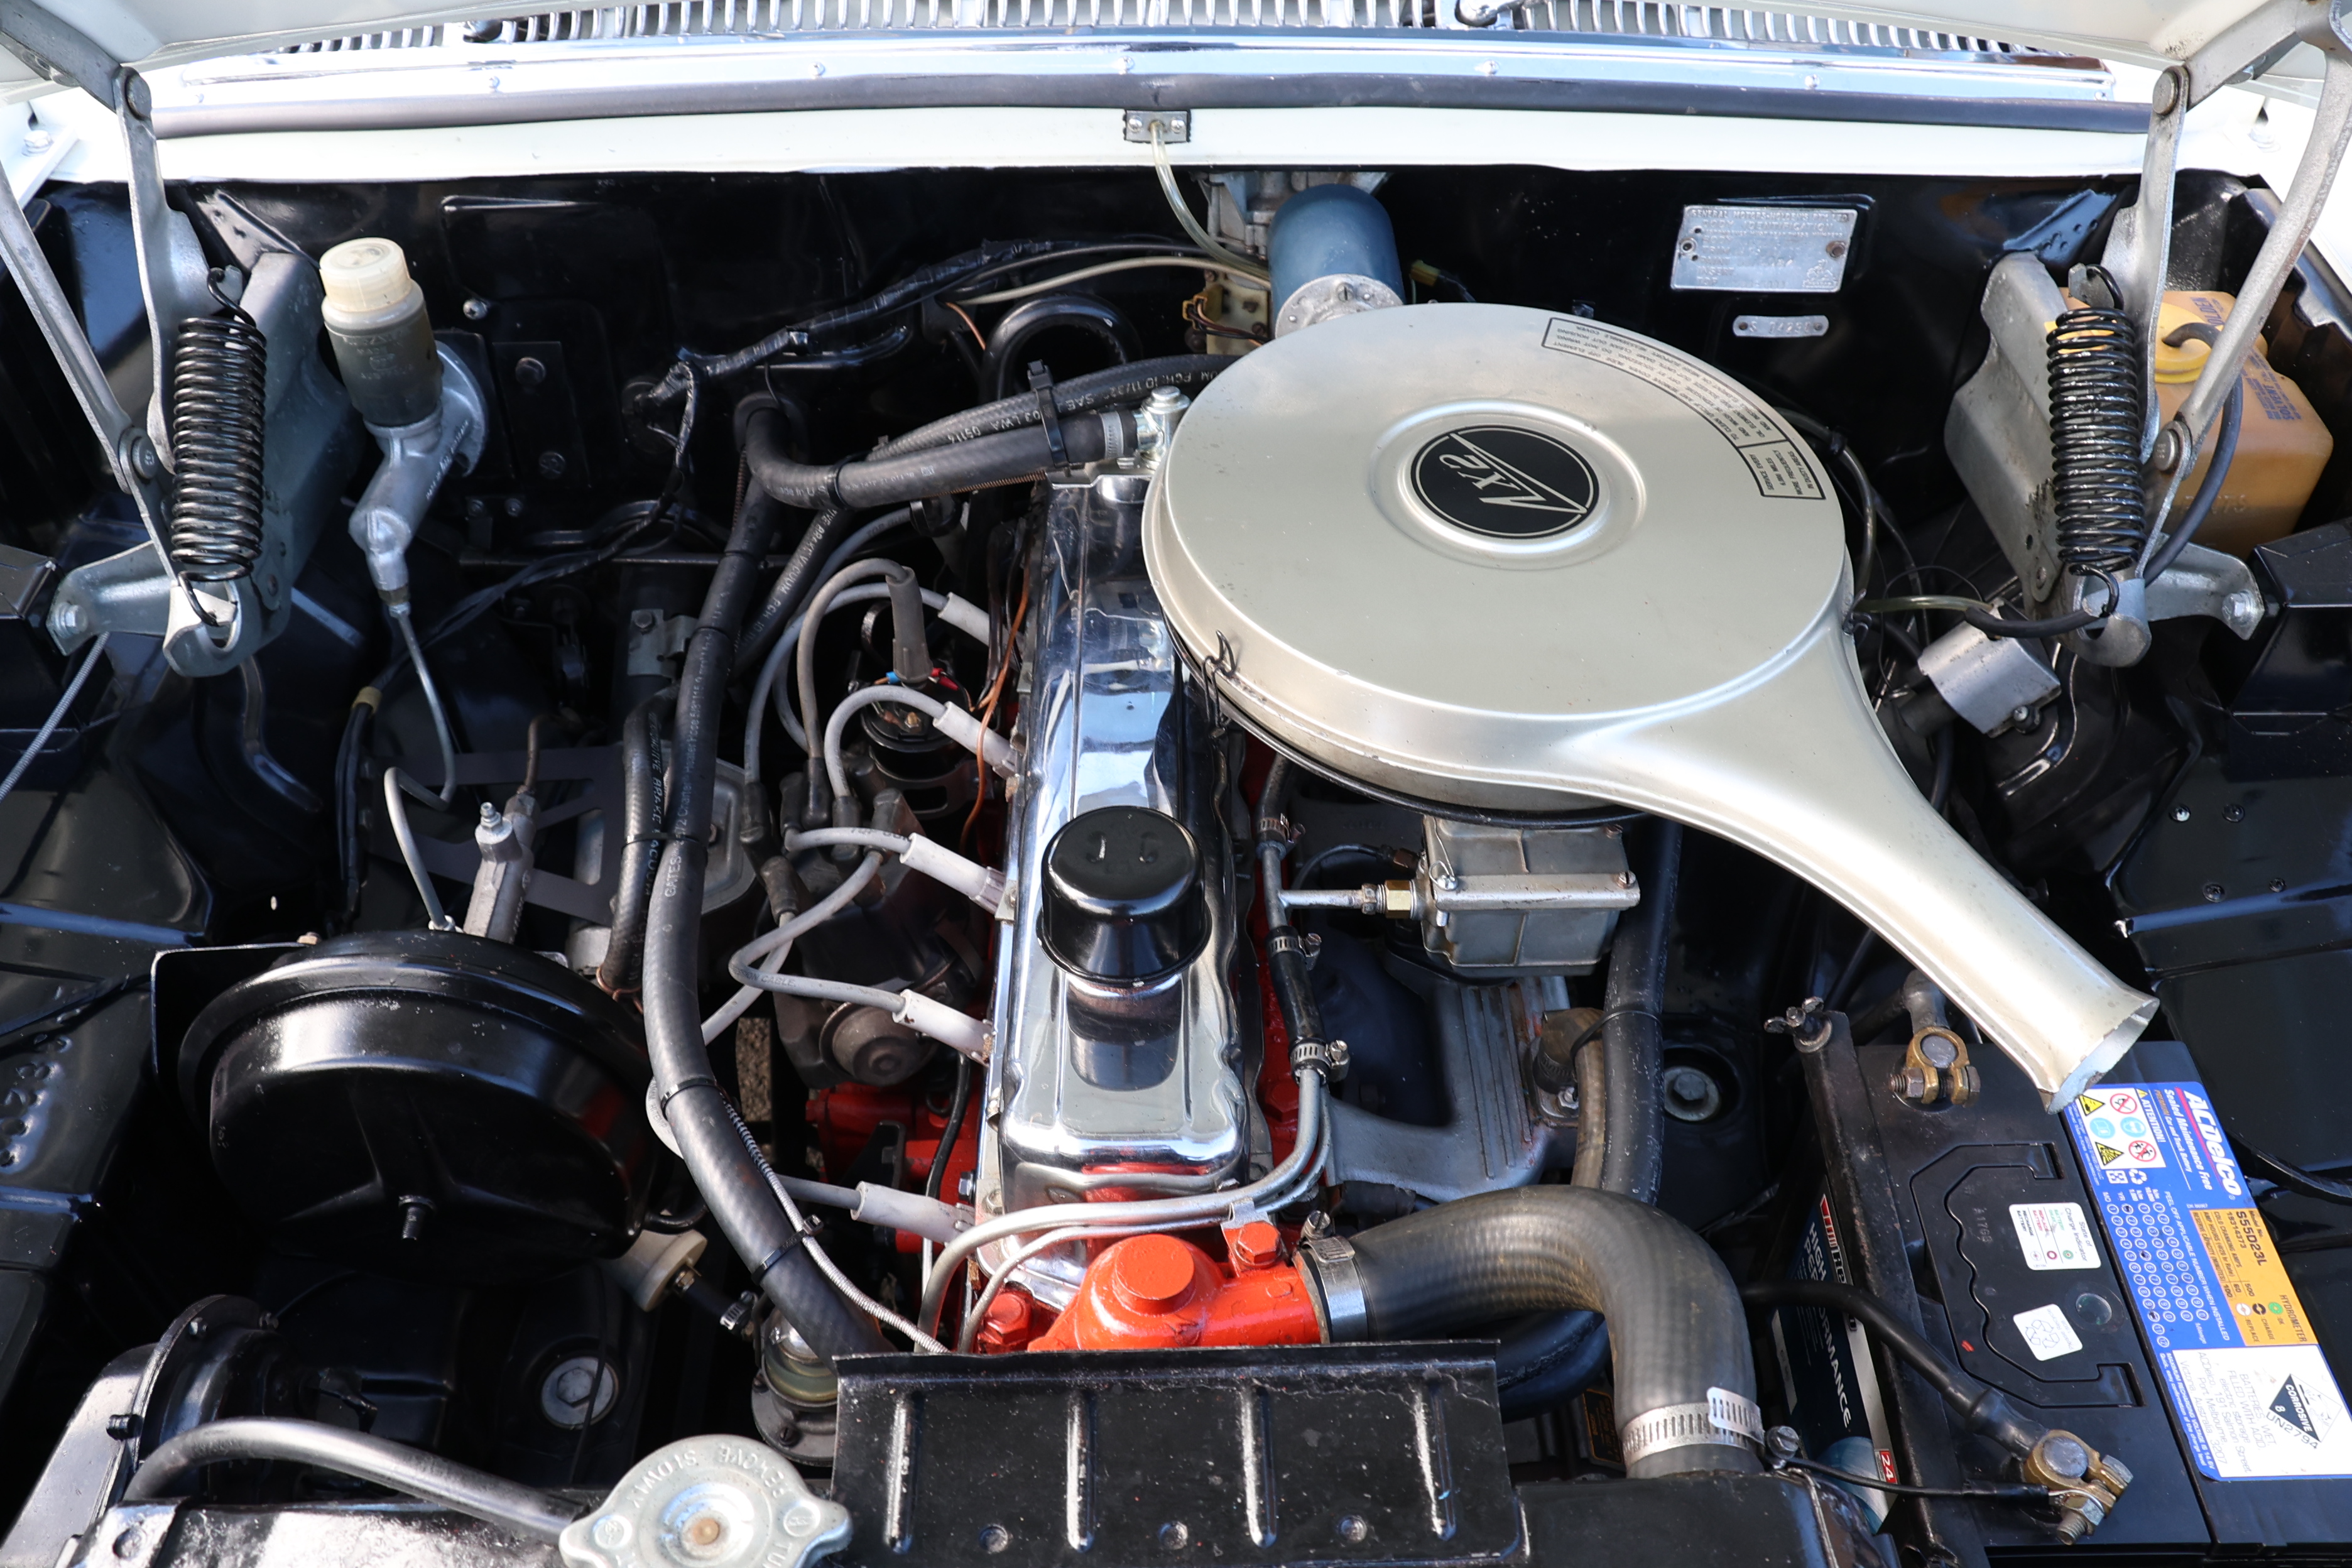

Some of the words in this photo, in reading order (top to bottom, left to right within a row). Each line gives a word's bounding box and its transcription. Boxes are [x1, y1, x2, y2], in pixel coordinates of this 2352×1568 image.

[1690, 207, 1729, 219] GENERAL
[1743, 218, 1834, 233] IDENTIFICATION
[1759, 470, 1775, 490] SERVICE
[663, 854, 682, 898] GATES
[2139, 1097, 2167, 1143] ATTENTION!
[2164, 1115, 2175, 1126] Car
[2168, 1125, 2179, 1137] and
[2162, 1087, 2185, 1118] Sealed
[2174, 1116, 2206, 1171] Maintenance
[2197, 1170, 2216, 1191] Free
[2172, 1136, 2186, 1152] Truck
[2182, 1088, 2247, 1197] ACDelco
[2177, 1152, 2194, 1173] Battery
[2163, 1190, 2176, 1207] PEEL
[2169, 1207, 2181, 1221] OFF
[2064, 1207, 2076, 1231] Charge
[2073, 1232, 2088, 1261] Indicator
[2078, 1221, 2089, 1238] State
[2202, 1211, 2213, 1223] AMP
[2208, 1223, 2221, 1242] HOURS
[2248, 1210, 2260, 1228] Model
[1809, 1222, 1827, 1282] HIGH
[2175, 1219, 2196, 1258] APPLICABLE
[2213, 1211, 2224, 1225] COLD
[2219, 1225, 2236, 1252] CRANKING
[2231, 1252, 2243, 1268] AMPS
[2243, 1282, 2255, 1297] 500
[2235, 1210, 2268, 1266] S55D23L
[2191, 1211, 2206, 1233] RESERVE
[2201, 1233, 2216, 1256] CAPACITY
[2222, 1283, 2233, 1298] 100
[2190, 1257, 2208, 1285] NUMBER
[2201, 1284, 2216, 1305] WHEN
[2193, 1322, 2208, 1344] Mileage
[2209, 1305, 2231, 1341] INSTALLED
[2278, 1293, 2308, 1343] HYDROMETER
[2164, 1352, 2182, 1381] MAXIMUM
[2175, 1381, 2196, 1418] RECHARGING
[2190, 1418, 2206, 1444] VOLTAGE
[2195, 1376, 2212, 1396] Port
[2213, 1391, 2228, 1409] 191
[2226, 1369, 2246, 1398] FILLED
[2239, 1400, 2257, 1424] WITH
[2164, 1369, 2174, 1383] easy
[2169, 1382, 2188, 1416] confirmation
[2185, 1422, 2194, 1432] the
[2197, 1453, 2207, 1466] level
[2218, 1378, 2238, 1408] electric
[2229, 1410, 2252, 1444] storage
[2238, 1373, 2267, 1422] BATTERIES,
[2258, 1424, 2277, 1446] WET,
[2273, 1403, 2287, 1413] 8
[2284, 1383, 2313, 1433] CORROSIVE
[2220, 1410, 2242, 1444] Salmon
[2265, 1410, 2319, 1450] UN2794
[1880, 1451, 1893, 1483] 24
[2209, 1438, 2228, 1465] 3207
[2234, 1445, 2254, 1474] Street
